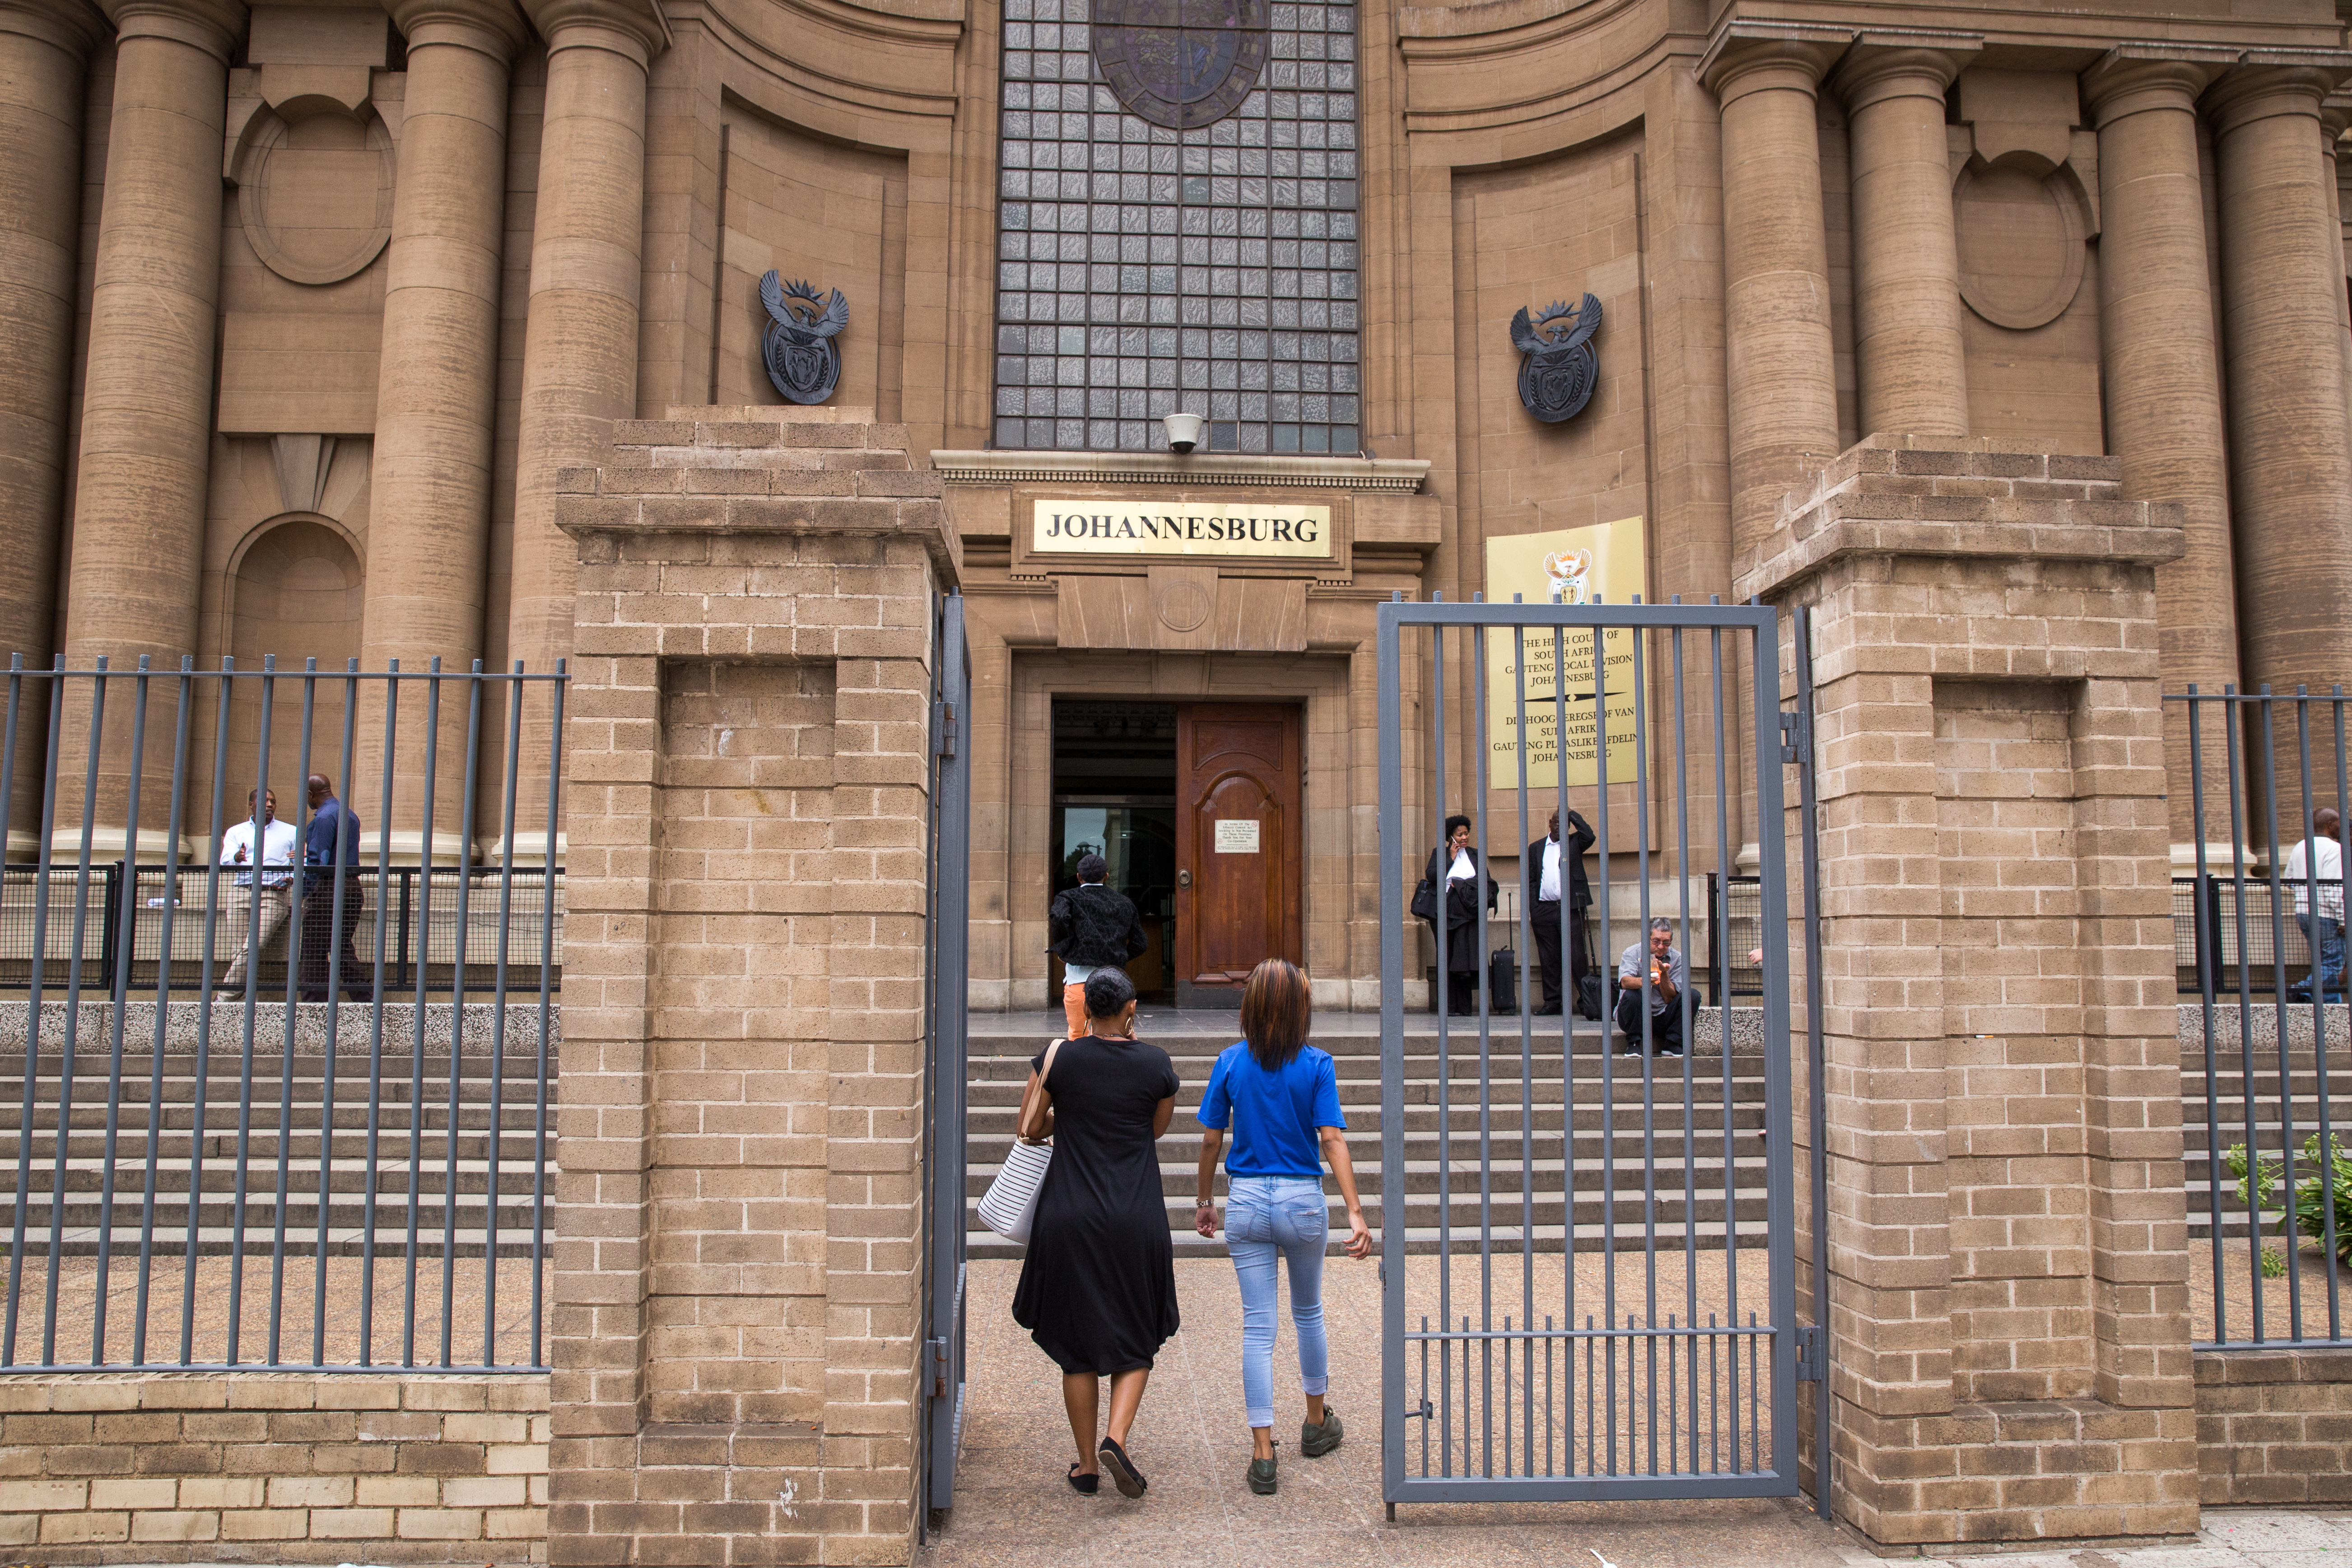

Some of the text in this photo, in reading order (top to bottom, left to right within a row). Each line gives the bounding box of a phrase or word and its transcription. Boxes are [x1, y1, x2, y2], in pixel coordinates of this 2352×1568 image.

[1046, 514, 1319, 542] JOHANNESBURG
[1543, 636, 1569, 647] HIH
[1607, 630, 1619, 639] OF
[1534, 649, 1568, 659] SOUH
[1505, 663, 1554, 674] GATENG
[1563, 660, 1589, 670] OCAL
[1531, 670, 1609, 687] JOHANESBUG
[1506, 717, 1517, 725] DI
[1615, 707, 1634, 717] VAN
[1541, 724, 1597, 736] SUI AFRIK
[1546, 737, 1597, 749] PLASLIKE
[1532, 749, 1611, 764] JOHANESBUG
